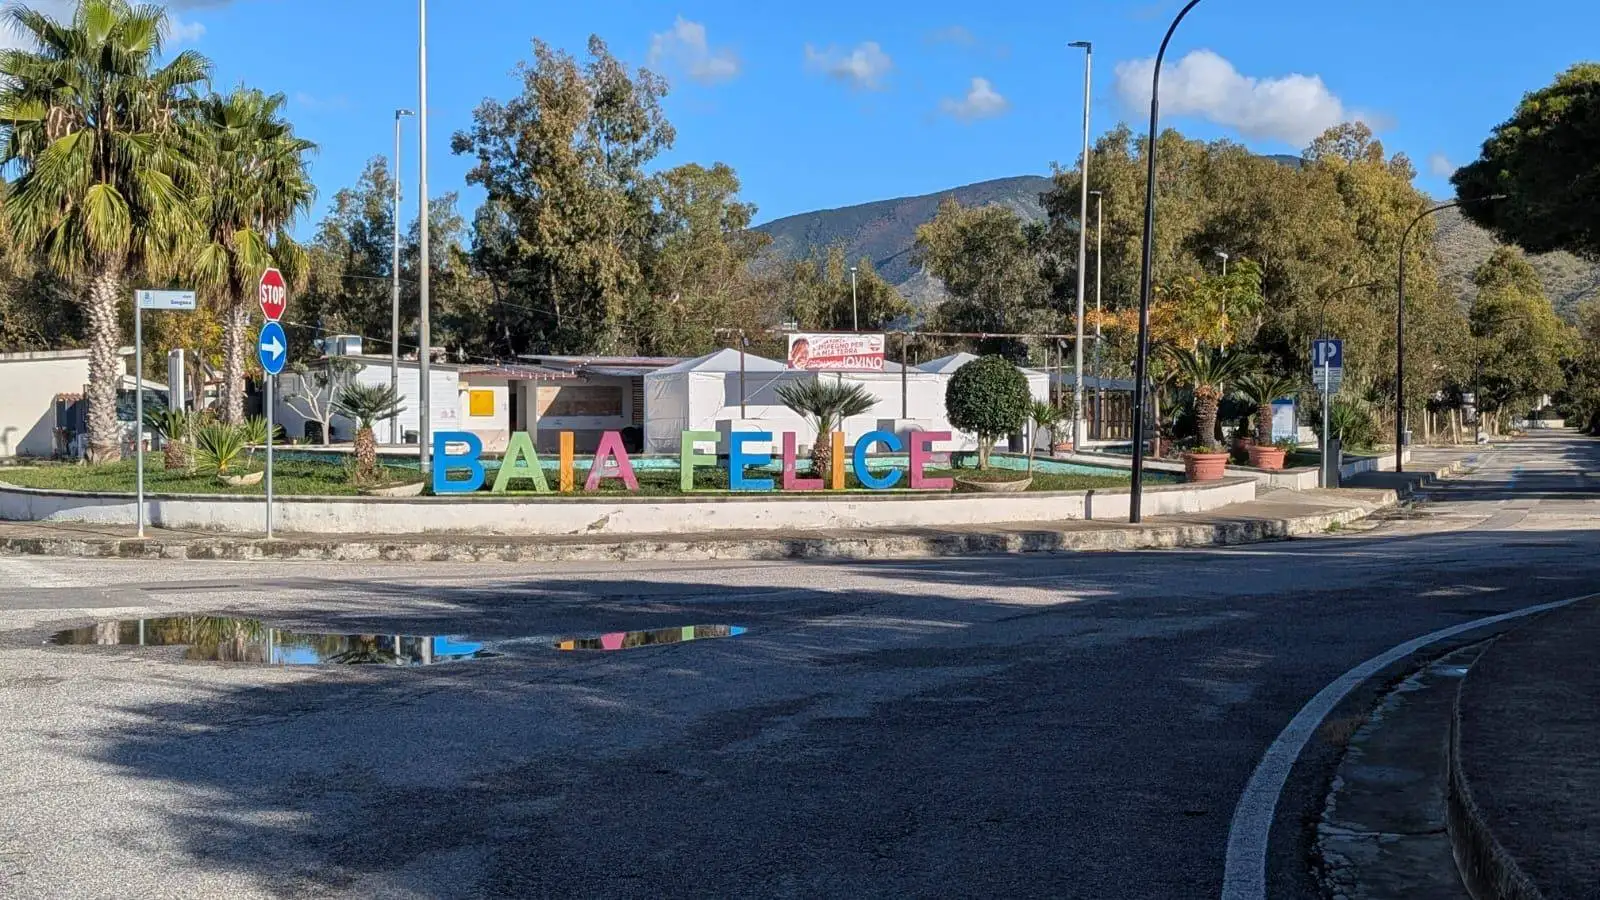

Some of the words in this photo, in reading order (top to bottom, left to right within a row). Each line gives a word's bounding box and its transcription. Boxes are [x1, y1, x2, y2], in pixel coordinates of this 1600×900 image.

[261, 284, 284, 305] STOP
[1318, 342, 1337, 366] P
[433, 431, 640, 493] BAIA
[680, 430, 954, 491] FELICE
